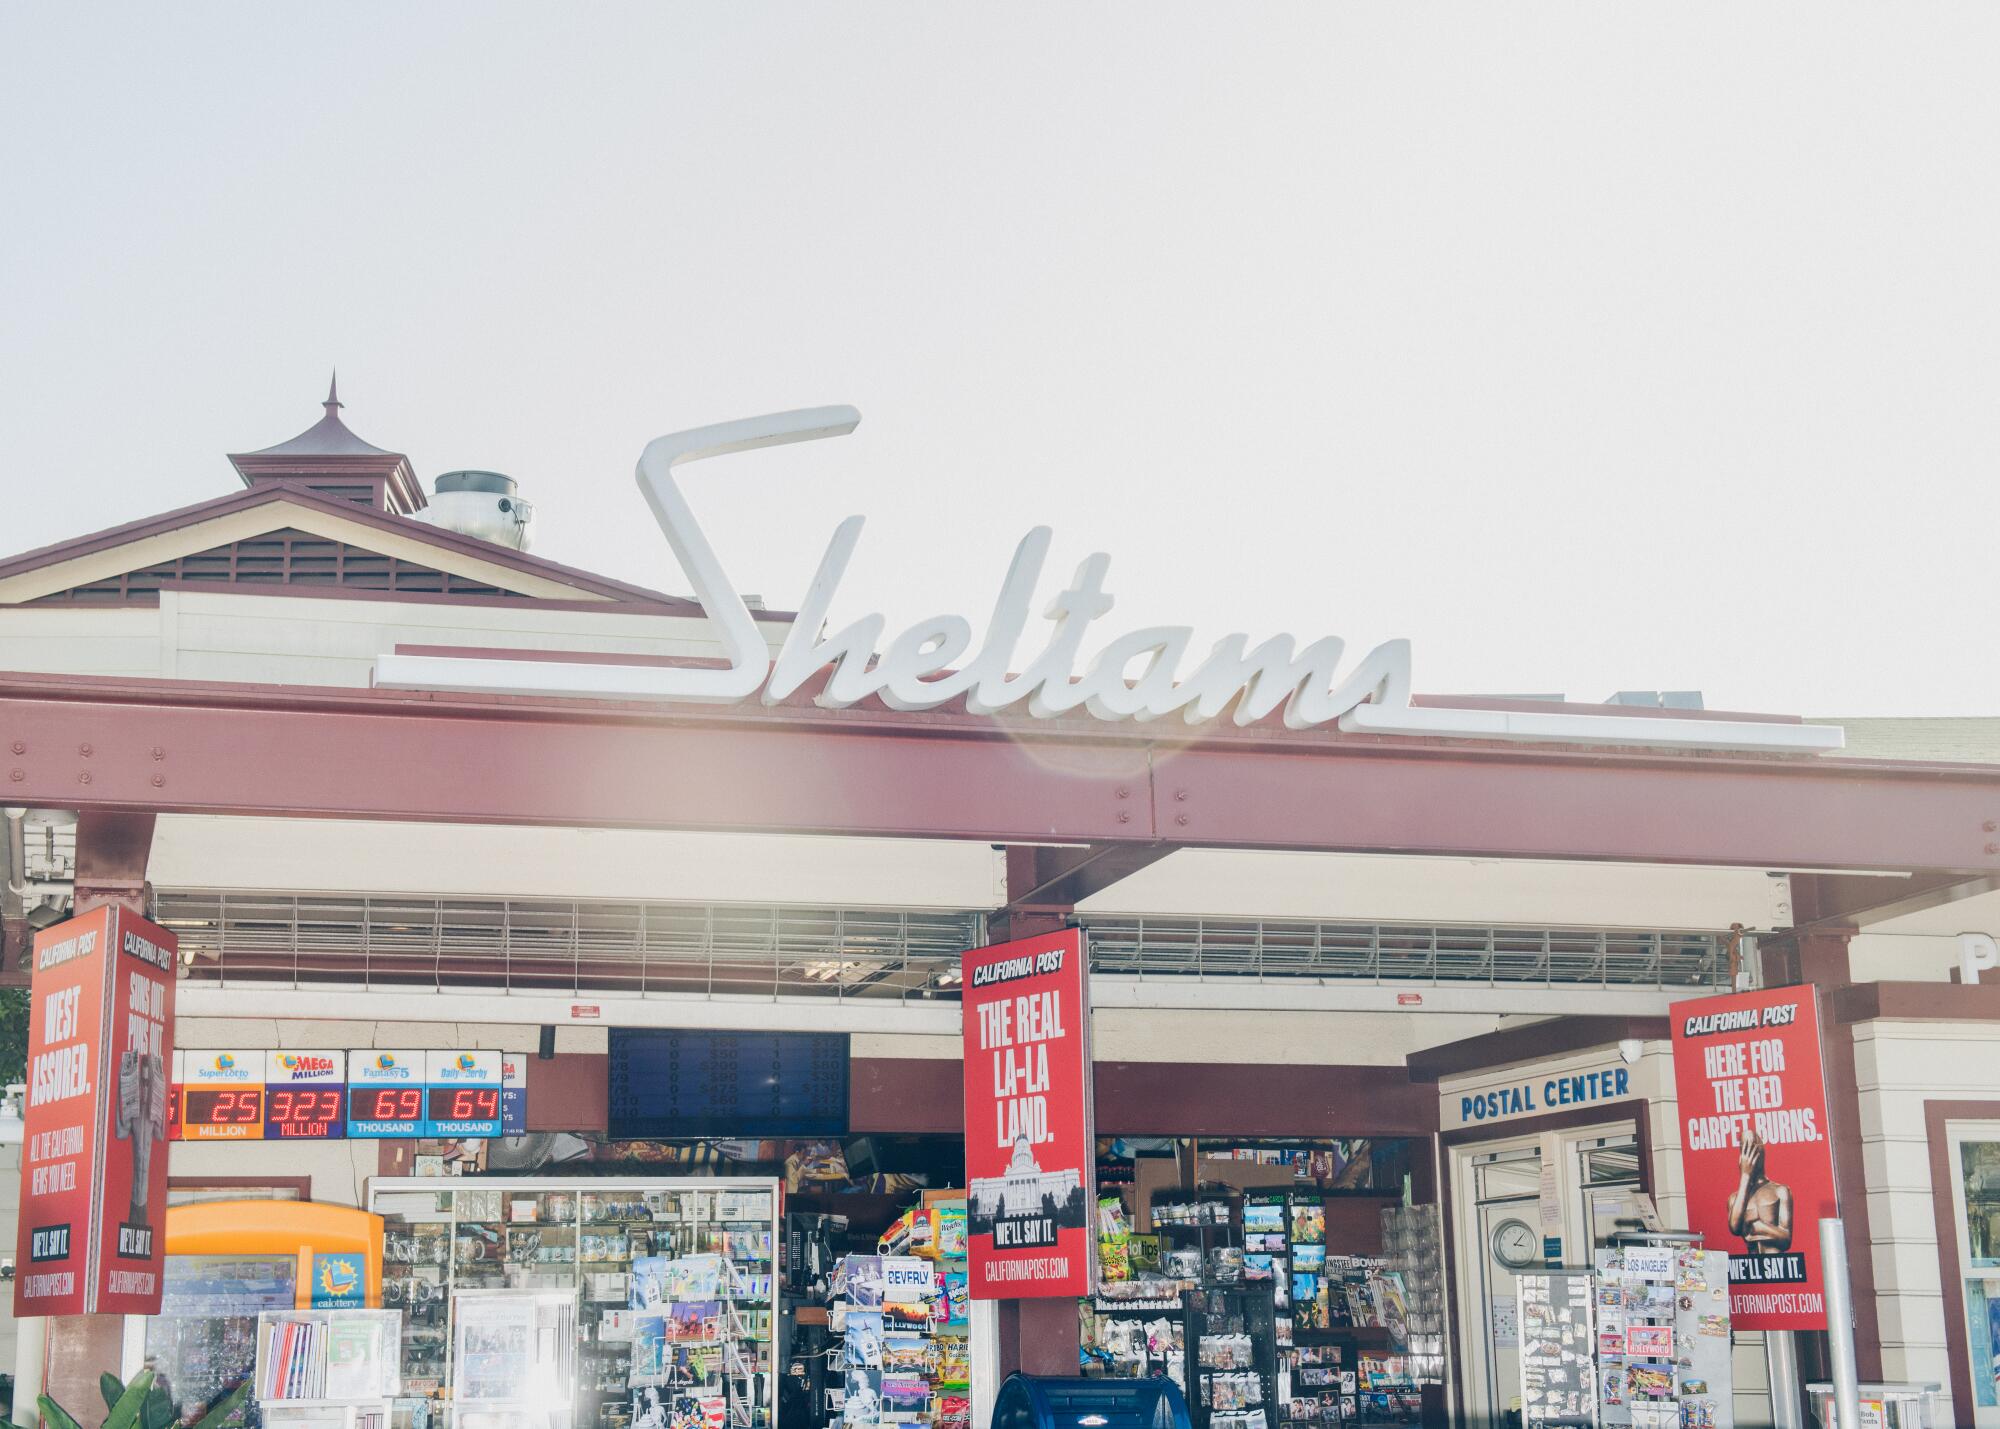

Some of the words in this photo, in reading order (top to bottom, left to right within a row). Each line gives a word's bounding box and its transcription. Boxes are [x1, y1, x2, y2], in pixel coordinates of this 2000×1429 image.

[39, 937, 77, 970] CALIFORNIA
[77, 930, 97, 957] POST
[124, 930, 157, 964] CALIFORNIA
[157, 946, 172, 971] POST
[973, 957, 1033, 988] CALIFORNIA
[1034, 949, 1065, 974] POST
[129, 971, 150, 1016] SUNS
[150, 980, 165, 1023] OUT.
[44, 984, 81, 1046] WEST
[977, 999, 1013, 1050] THE
[1016, 990, 1065, 1044] REAL
[1684, 1008, 1759, 1038] CALIFORNIA
[1760, 1003, 1798, 1029] POST
[128, 1012, 149, 1056] PUNS
[294, 1055, 334, 1071] MEGA
[363, 1067, 398, 1079] Fantasy
[400, 1067, 410, 1078] 5
[993, 1044, 1050, 1098] LA-LA
[1704, 1042, 1748, 1079] HERE
[1750, 1038, 1785, 1075] FOR
[30, 1043, 91, 1108] ASSURED.
[198, 1068, 249, 1080] SuperLotto
[291, 1069, 334, 1080] MILLIONS
[440, 1068, 459, 1079] Daily
[212, 1092, 258, 1122] 25
[271, 1092, 341, 1122] 323
[375, 1090, 421, 1119] 69
[453, 1090, 498, 1119] 64
[1461, 1085, 1536, 1122] POSTAL
[1544, 1067, 1629, 1108] CENTER
[1711, 1078, 1746, 1113] THE
[1747, 1075, 1783, 1110] RED
[199, 1126, 247, 1136] MILLION
[281, 1122, 328, 1136] MILLION
[357, 1123, 415, 1133] THOUSAND
[436, 1122, 493, 1132] THOUSAND
[996, 1095, 1054, 1149] LAND.
[1688, 1113, 1750, 1151] CARPET
[1754, 1107, 1823, 1145] BURNS.
[30, 1133, 40, 1163] ALL
[40, 1131, 51, 1161] THE
[51, 1124, 84, 1158] CALIFORNIA
[32, 1166, 48, 1196] NEWS
[49, 1163, 60, 1193] YOU
[60, 1161, 77, 1191] NEED.
[33, 1231, 48, 1258] WE'LL
[49, 1230, 60, 1256] SAY
[60, 1228, 68, 1255] IT.
[119, 1227, 135, 1254] WE'LL
[135, 1229, 145, 1255] SAY
[995, 1221, 1023, 1246] WE'LL
[1023, 1219, 1041, 1244] SAY
[1042, 1218, 1055, 1243] IT.
[888, 1270, 929, 1285] BEVERLY
[985, 1257, 1069, 1282] CALIFORNIAPOST.COM
[1627, 1258, 1640, 1272] LOS
[1640, 1259, 1668, 1273] ANGELES
[1728, 1258, 1762, 1280] WE'LL
[1763, 1257, 1785, 1279] SAY
[1787, 1256, 1803, 1279] IT.
[23, 1271, 75, 1298] CALIFORNIAPOST.COM
[108, 1269, 156, 1295] CALIFORNIAPOST.COM
[317, 1297, 358, 1309] calottery
[1729, 1292, 1823, 1314] LIFORNIAPOST.COM
[1629, 1344, 1669, 1354] HOLLYWOOD
